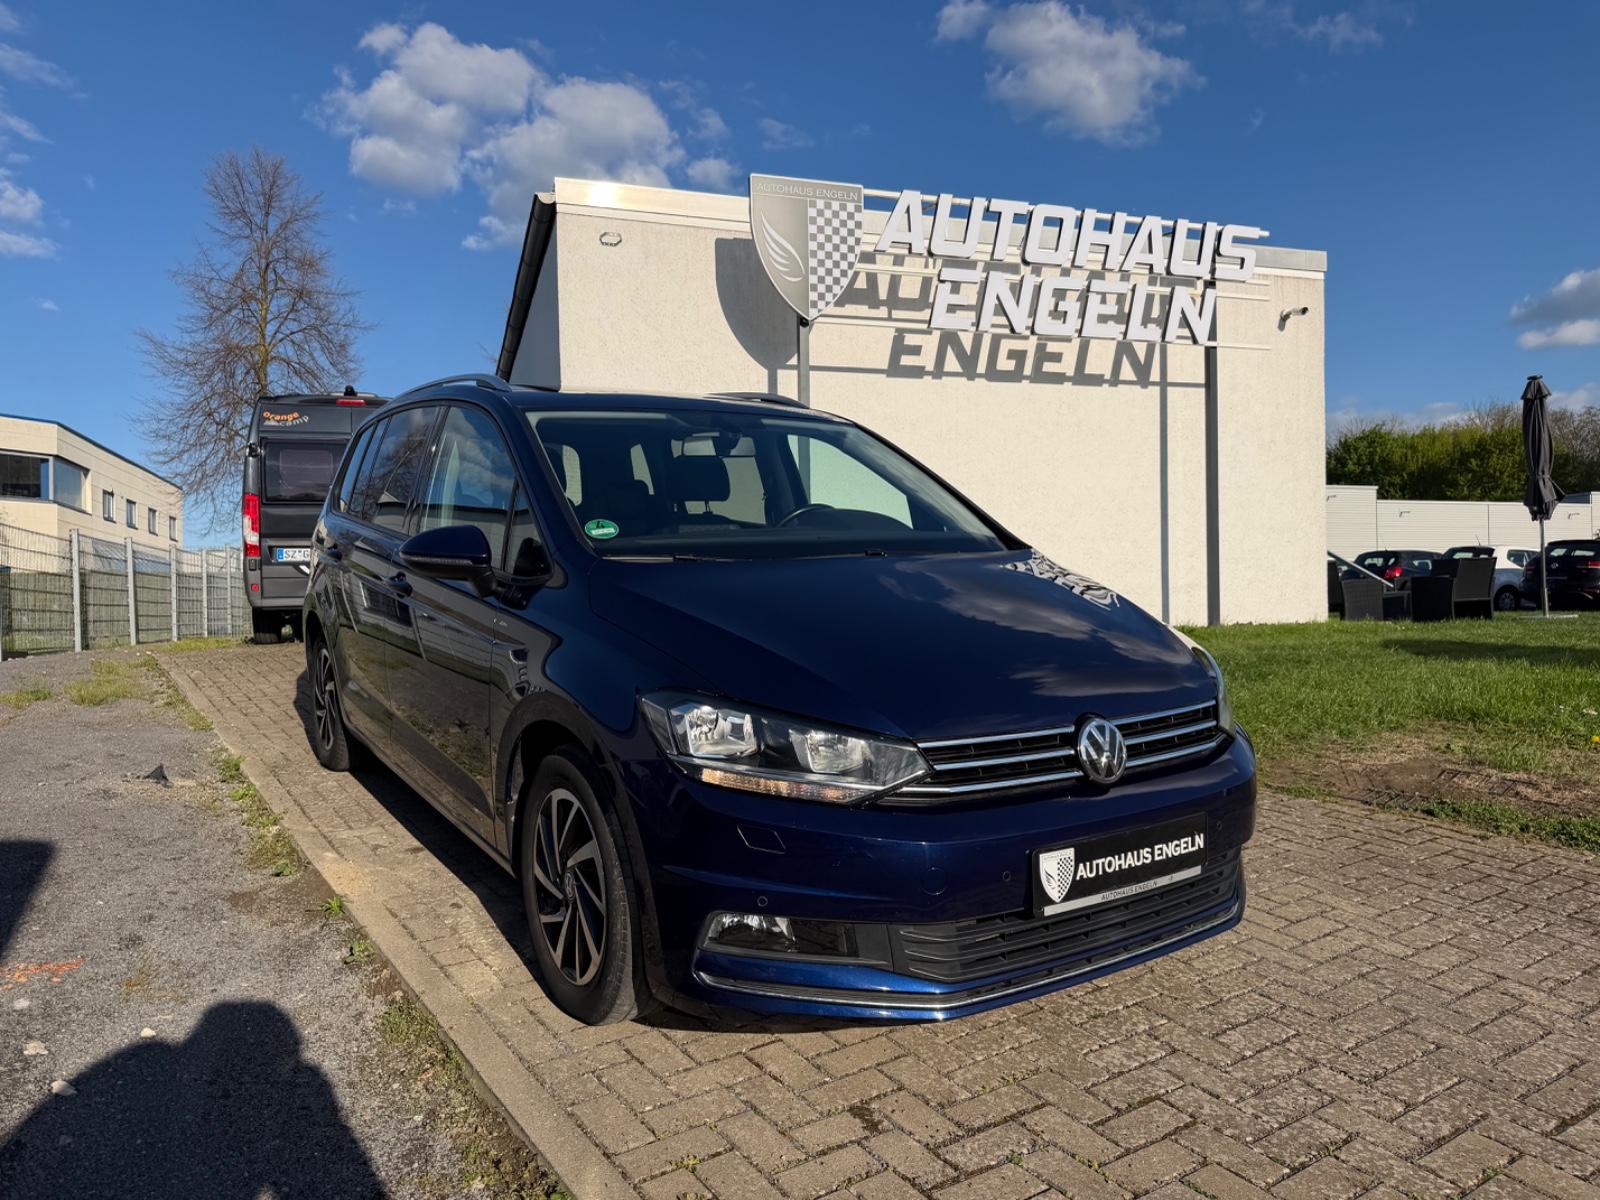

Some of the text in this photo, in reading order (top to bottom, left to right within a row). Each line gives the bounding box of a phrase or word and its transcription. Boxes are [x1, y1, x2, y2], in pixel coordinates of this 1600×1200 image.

[757, 183, 858, 201] AUTOHAUS ENGELN
[874, 189, 1260, 282] AUTOHAUS
[928, 266, 1217, 346] ENGELN
[284, 549, 297, 559] SZ
[1076, 833, 1204, 880] AUTOHAUS ENGELN
